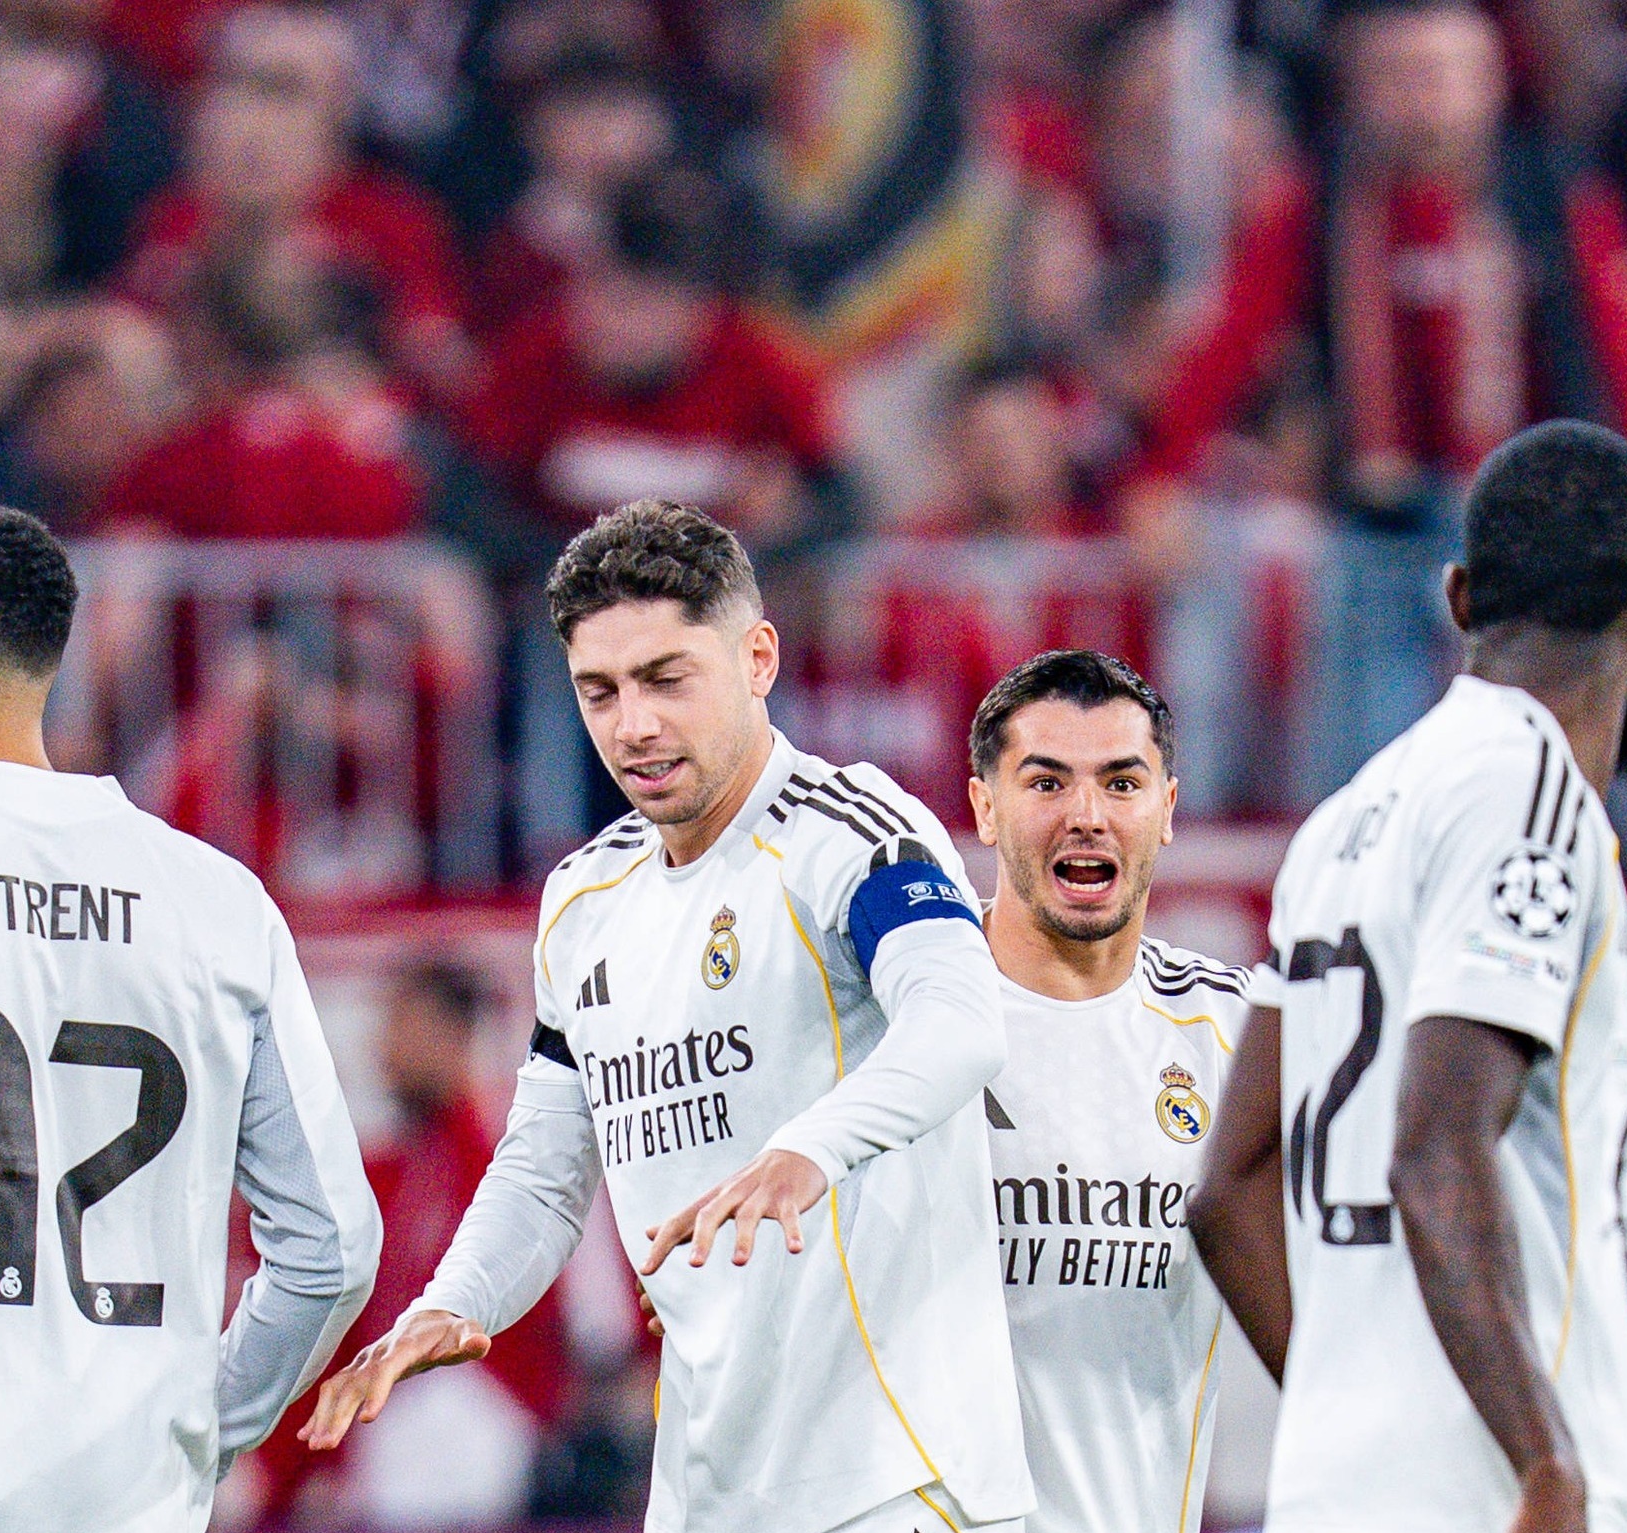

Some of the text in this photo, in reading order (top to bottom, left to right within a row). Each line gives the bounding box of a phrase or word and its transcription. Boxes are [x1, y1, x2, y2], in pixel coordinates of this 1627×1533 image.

[583, 1024, 754, 1110] Emirates
[606, 1091, 733, 1168] FLY BETTER
[999, 1237, 1172, 1290] LY BETTER
